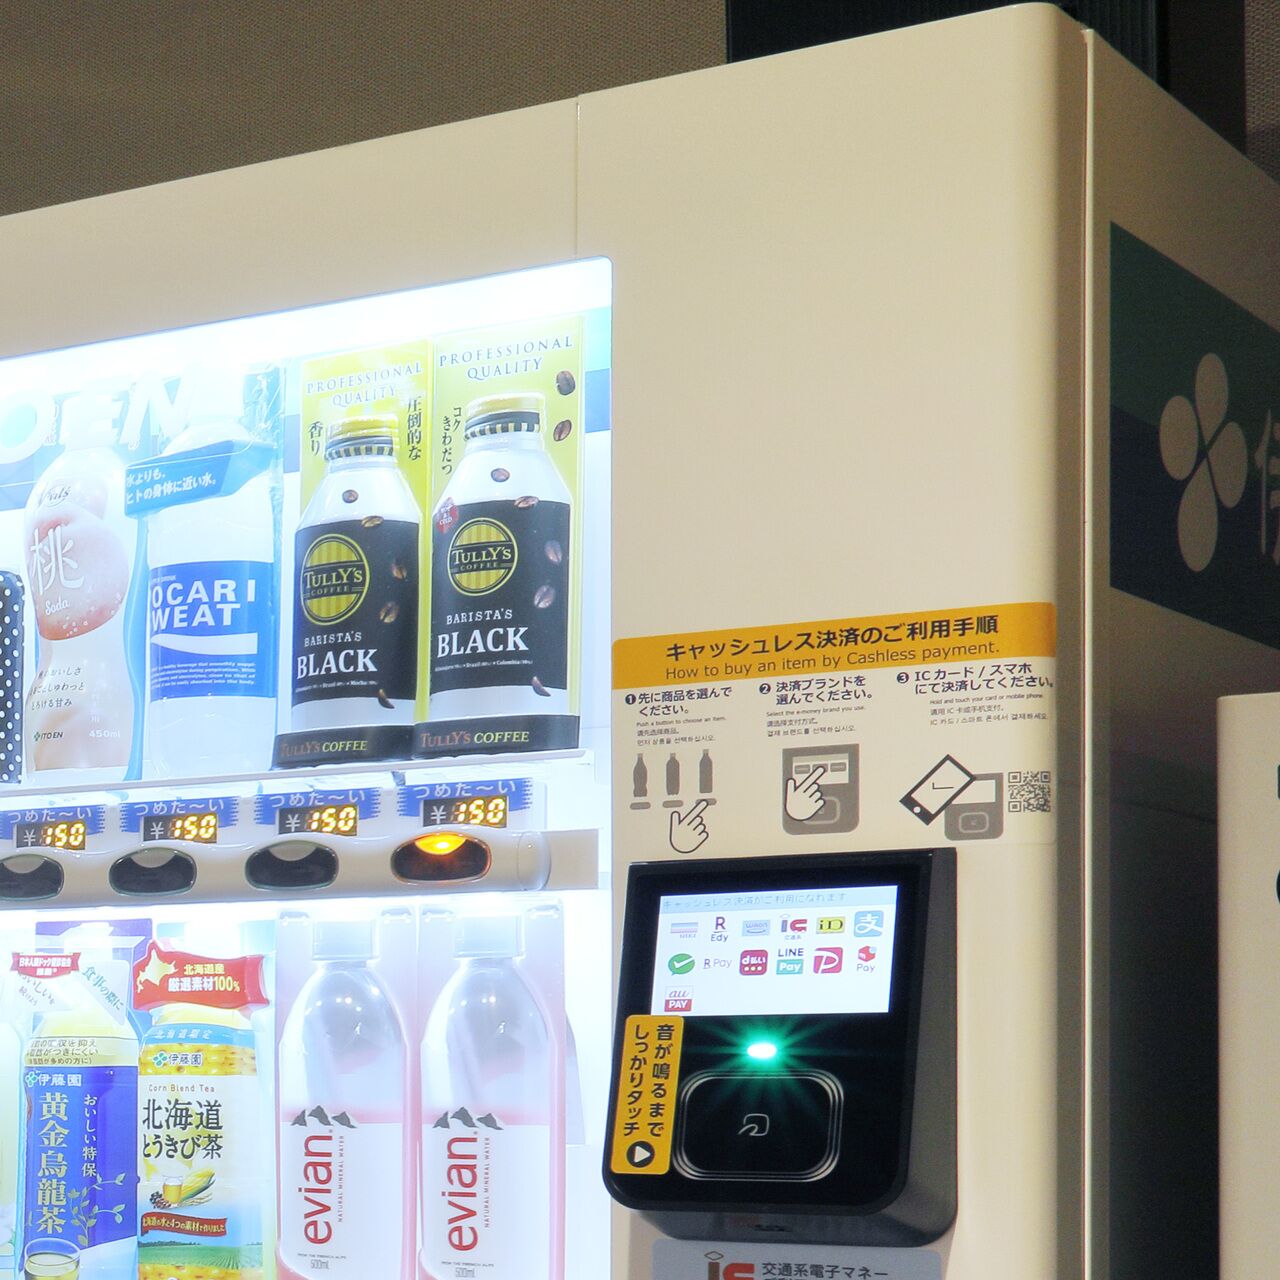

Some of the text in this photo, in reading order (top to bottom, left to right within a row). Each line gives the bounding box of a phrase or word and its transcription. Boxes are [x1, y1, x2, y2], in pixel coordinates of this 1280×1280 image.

[439, 335, 573, 367] PROFESSIONAL
[306, 362, 422, 395] PROFESSIONAL
[467, 357, 543, 380] QUALITY
[332, 386, 398, 408] QUALITY
[29, 524, 86, 597] 桃
[460, 561, 500, 571] COFFEE
[311, 584, 350, 597] COFFEE
[45, 598, 70, 616] Soda
[437, 627, 529, 659] BLACK
[666, 614, 999, 662] キャッシュレス決済のご利用手順
[297, 648, 378, 679] BLACK
[666, 642, 999, 680] How to buy an item by Cashless payment.
[915, 671, 930, 682] IC
[935, 666, 973, 680] カード
[990, 662, 1032, 675] スマホ
[776, 676, 866, 693] 決済ブランドを
[915, 676, 1054, 695] にて決済してください。
[776, 689, 873, 706] 選んでください。
[640, 704, 689, 717] ください。
[89, 729, 121, 740] 450ml
[474, 730, 529, 745] COFFEE
[711, 934, 728, 942] Edy
[778, 948, 804, 957] LINE
[183, 963, 225, 975] 北海道産
[168, 975, 241, 993] 厳選素材100%
[668, 1000, 688, 1008] PAY
[148, 1083, 216, 1093] Corn Blend Tea
[623, 1024, 649, 1137] しっかりタッチ
[648, 1024, 675, 1138] 音が鳴るまで
[142, 1098, 223, 1131] 北海道
[81, 1093, 98, 1178] おいしい特保
[142, 1133, 224, 1160] とうきび茶
[36, 1092, 70, 1235] 黄金烏龍茶
[303, 1134, 334, 1247] evian
[447, 1135, 479, 1254] evian
[762, 1262, 888, 1280] 交通系電子マネー
